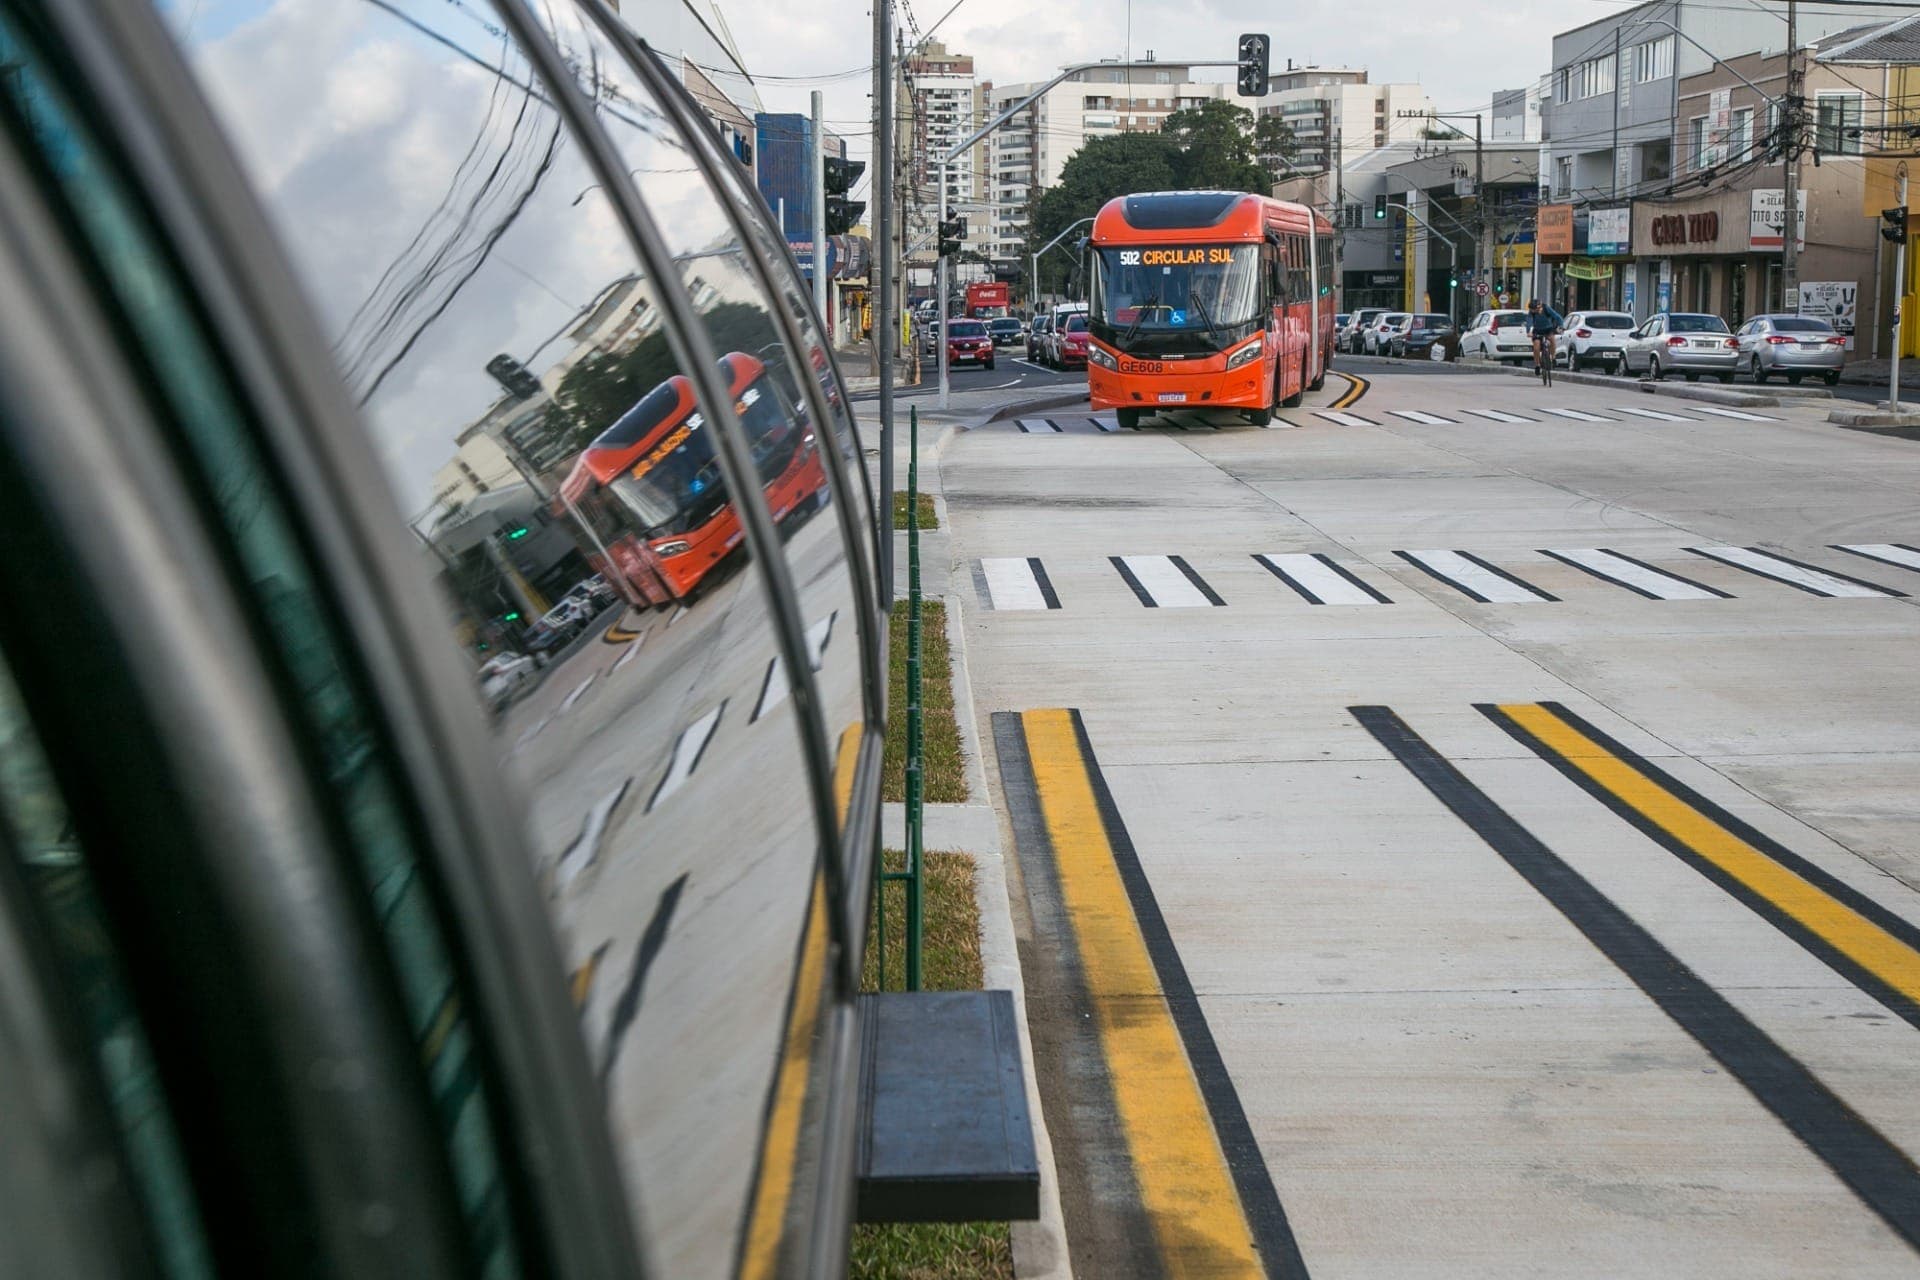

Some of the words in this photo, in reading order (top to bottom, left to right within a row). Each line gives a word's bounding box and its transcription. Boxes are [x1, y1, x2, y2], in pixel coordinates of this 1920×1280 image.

[1752, 210, 1771, 222] TITO
[1651, 214, 1686, 246] CASA
[1687, 211, 1718, 243] TITO
[1120, 251, 1140, 265] 502
[1143, 249, 1205, 264] CIRCULAR
[1209, 248, 1234, 262] SUL
[1120, 361, 1164, 373] GE608
